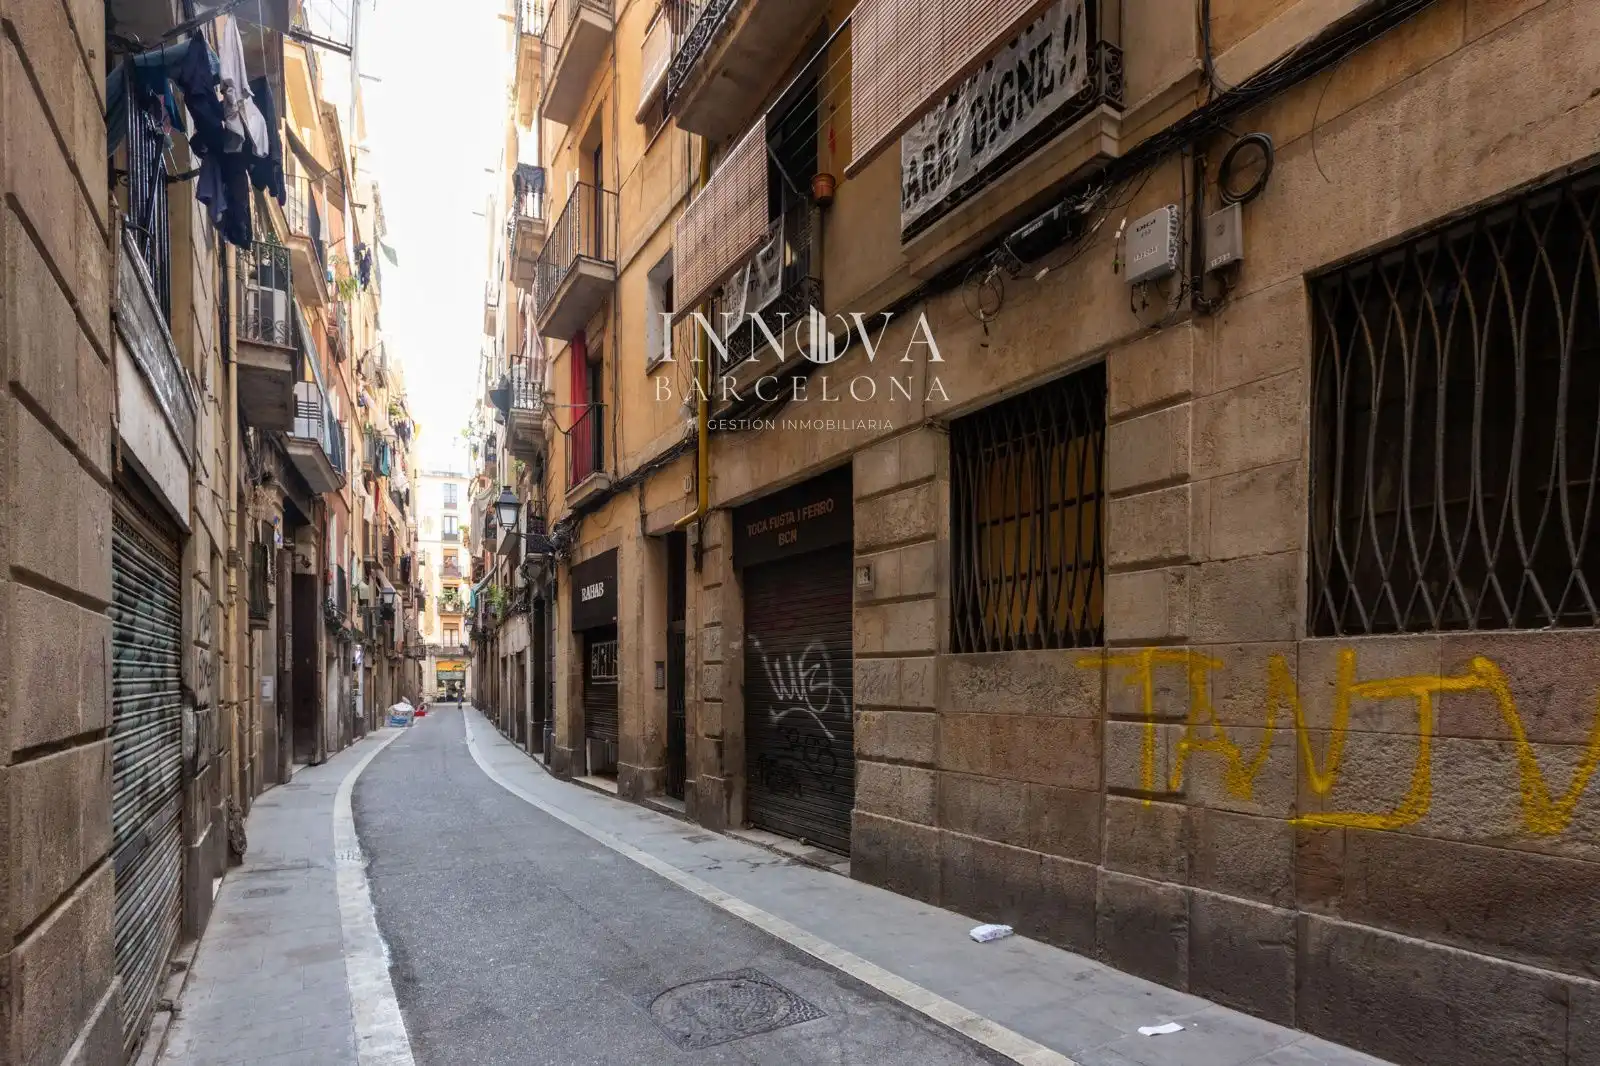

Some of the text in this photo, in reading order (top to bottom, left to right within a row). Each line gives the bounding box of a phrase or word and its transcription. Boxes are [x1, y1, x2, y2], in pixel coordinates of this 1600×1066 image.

[746, 519, 768, 538] TOCA
[769, 511, 795, 530] FUSTA
[802, 498, 834, 521] FERRO
[778, 528, 797, 547] BCN
